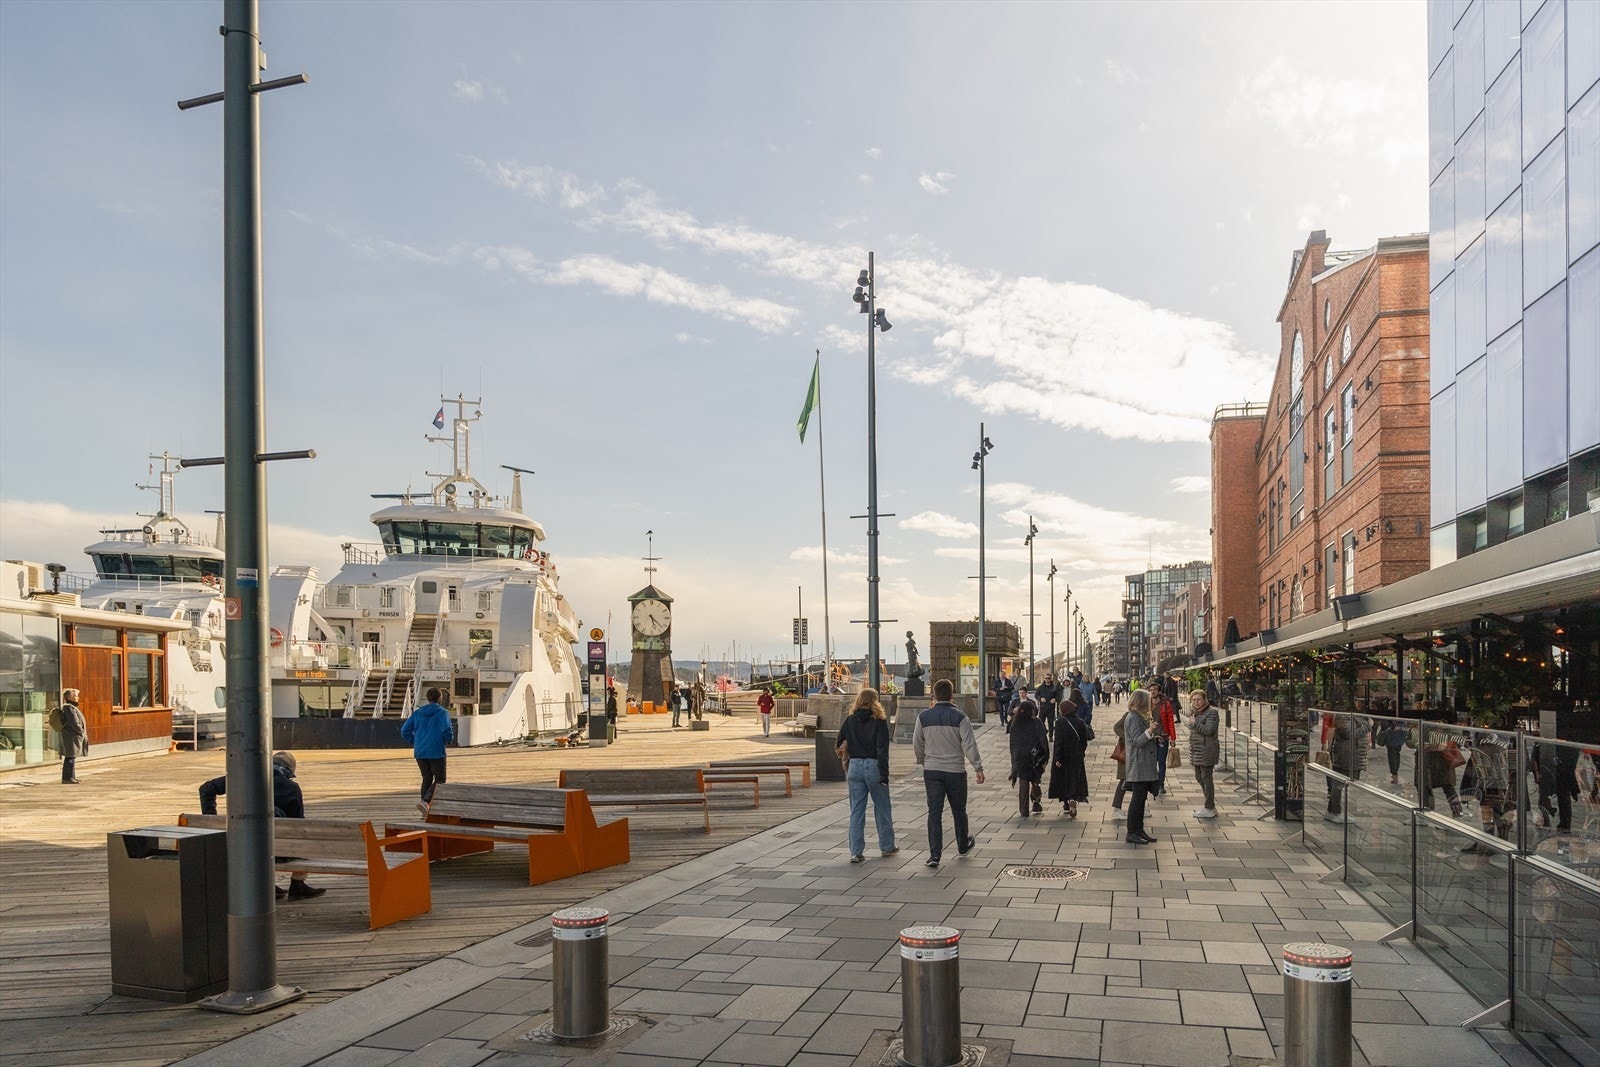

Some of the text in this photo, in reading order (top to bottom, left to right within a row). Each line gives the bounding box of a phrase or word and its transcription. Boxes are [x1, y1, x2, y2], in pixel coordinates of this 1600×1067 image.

[594, 630, 600, 638] A
[295, 670, 307, 678] Ikke
[310, 670, 328, 678] trafikk
